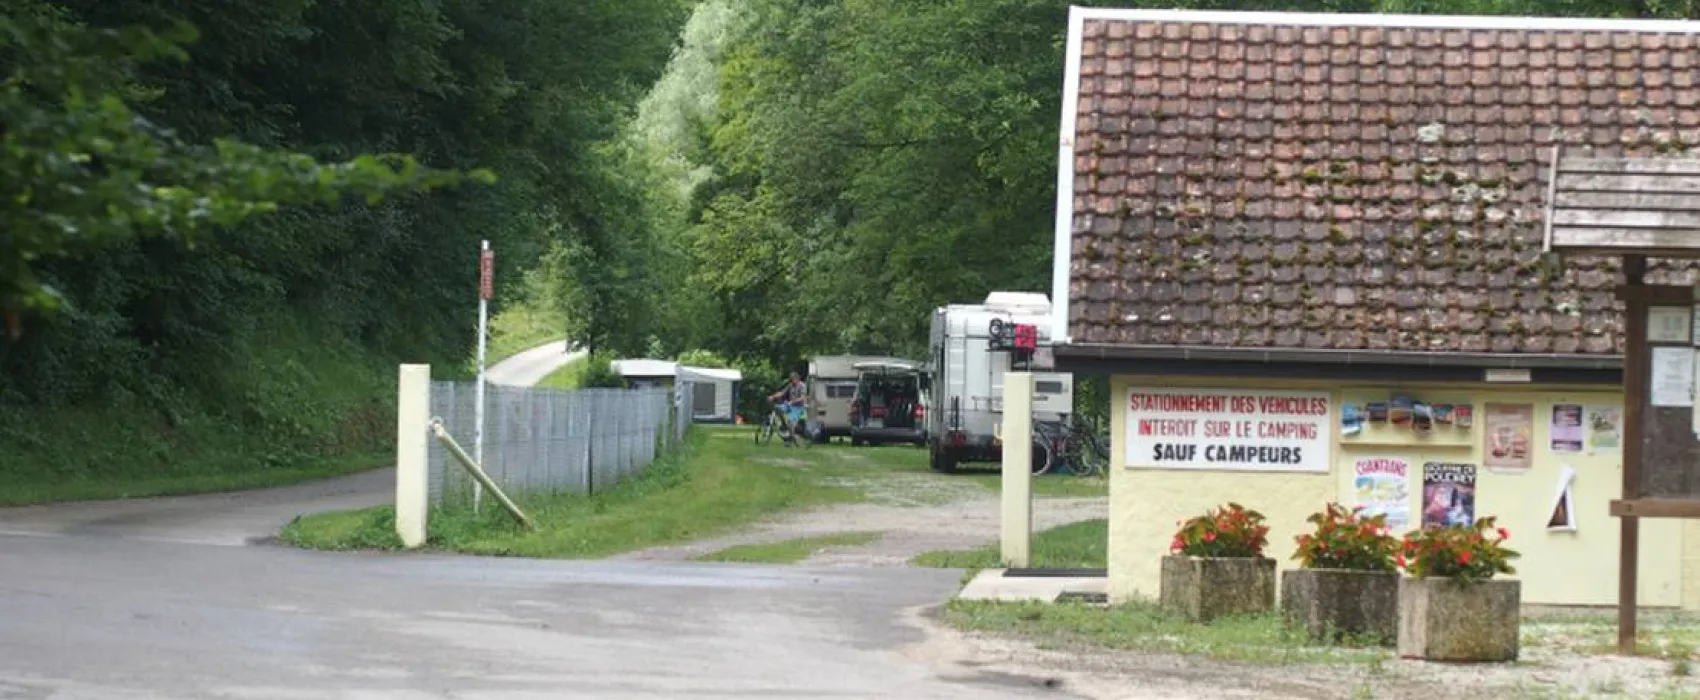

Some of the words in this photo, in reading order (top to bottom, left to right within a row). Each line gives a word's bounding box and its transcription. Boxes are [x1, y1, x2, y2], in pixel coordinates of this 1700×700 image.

[1131, 393, 1228, 413] STATIONNEMENT
[1231, 395, 1255, 414] DES
[1259, 396, 1327, 416] VEHICULES
[1138, 418, 1197, 436] INTERDIT
[1204, 420, 1230, 437] SUR
[1236, 420, 1250, 438] LE
[1258, 421, 1317, 440] CAMPING
[1153, 443, 1197, 462] SAUF
[1205, 445, 1302, 464] CAMPEURS
